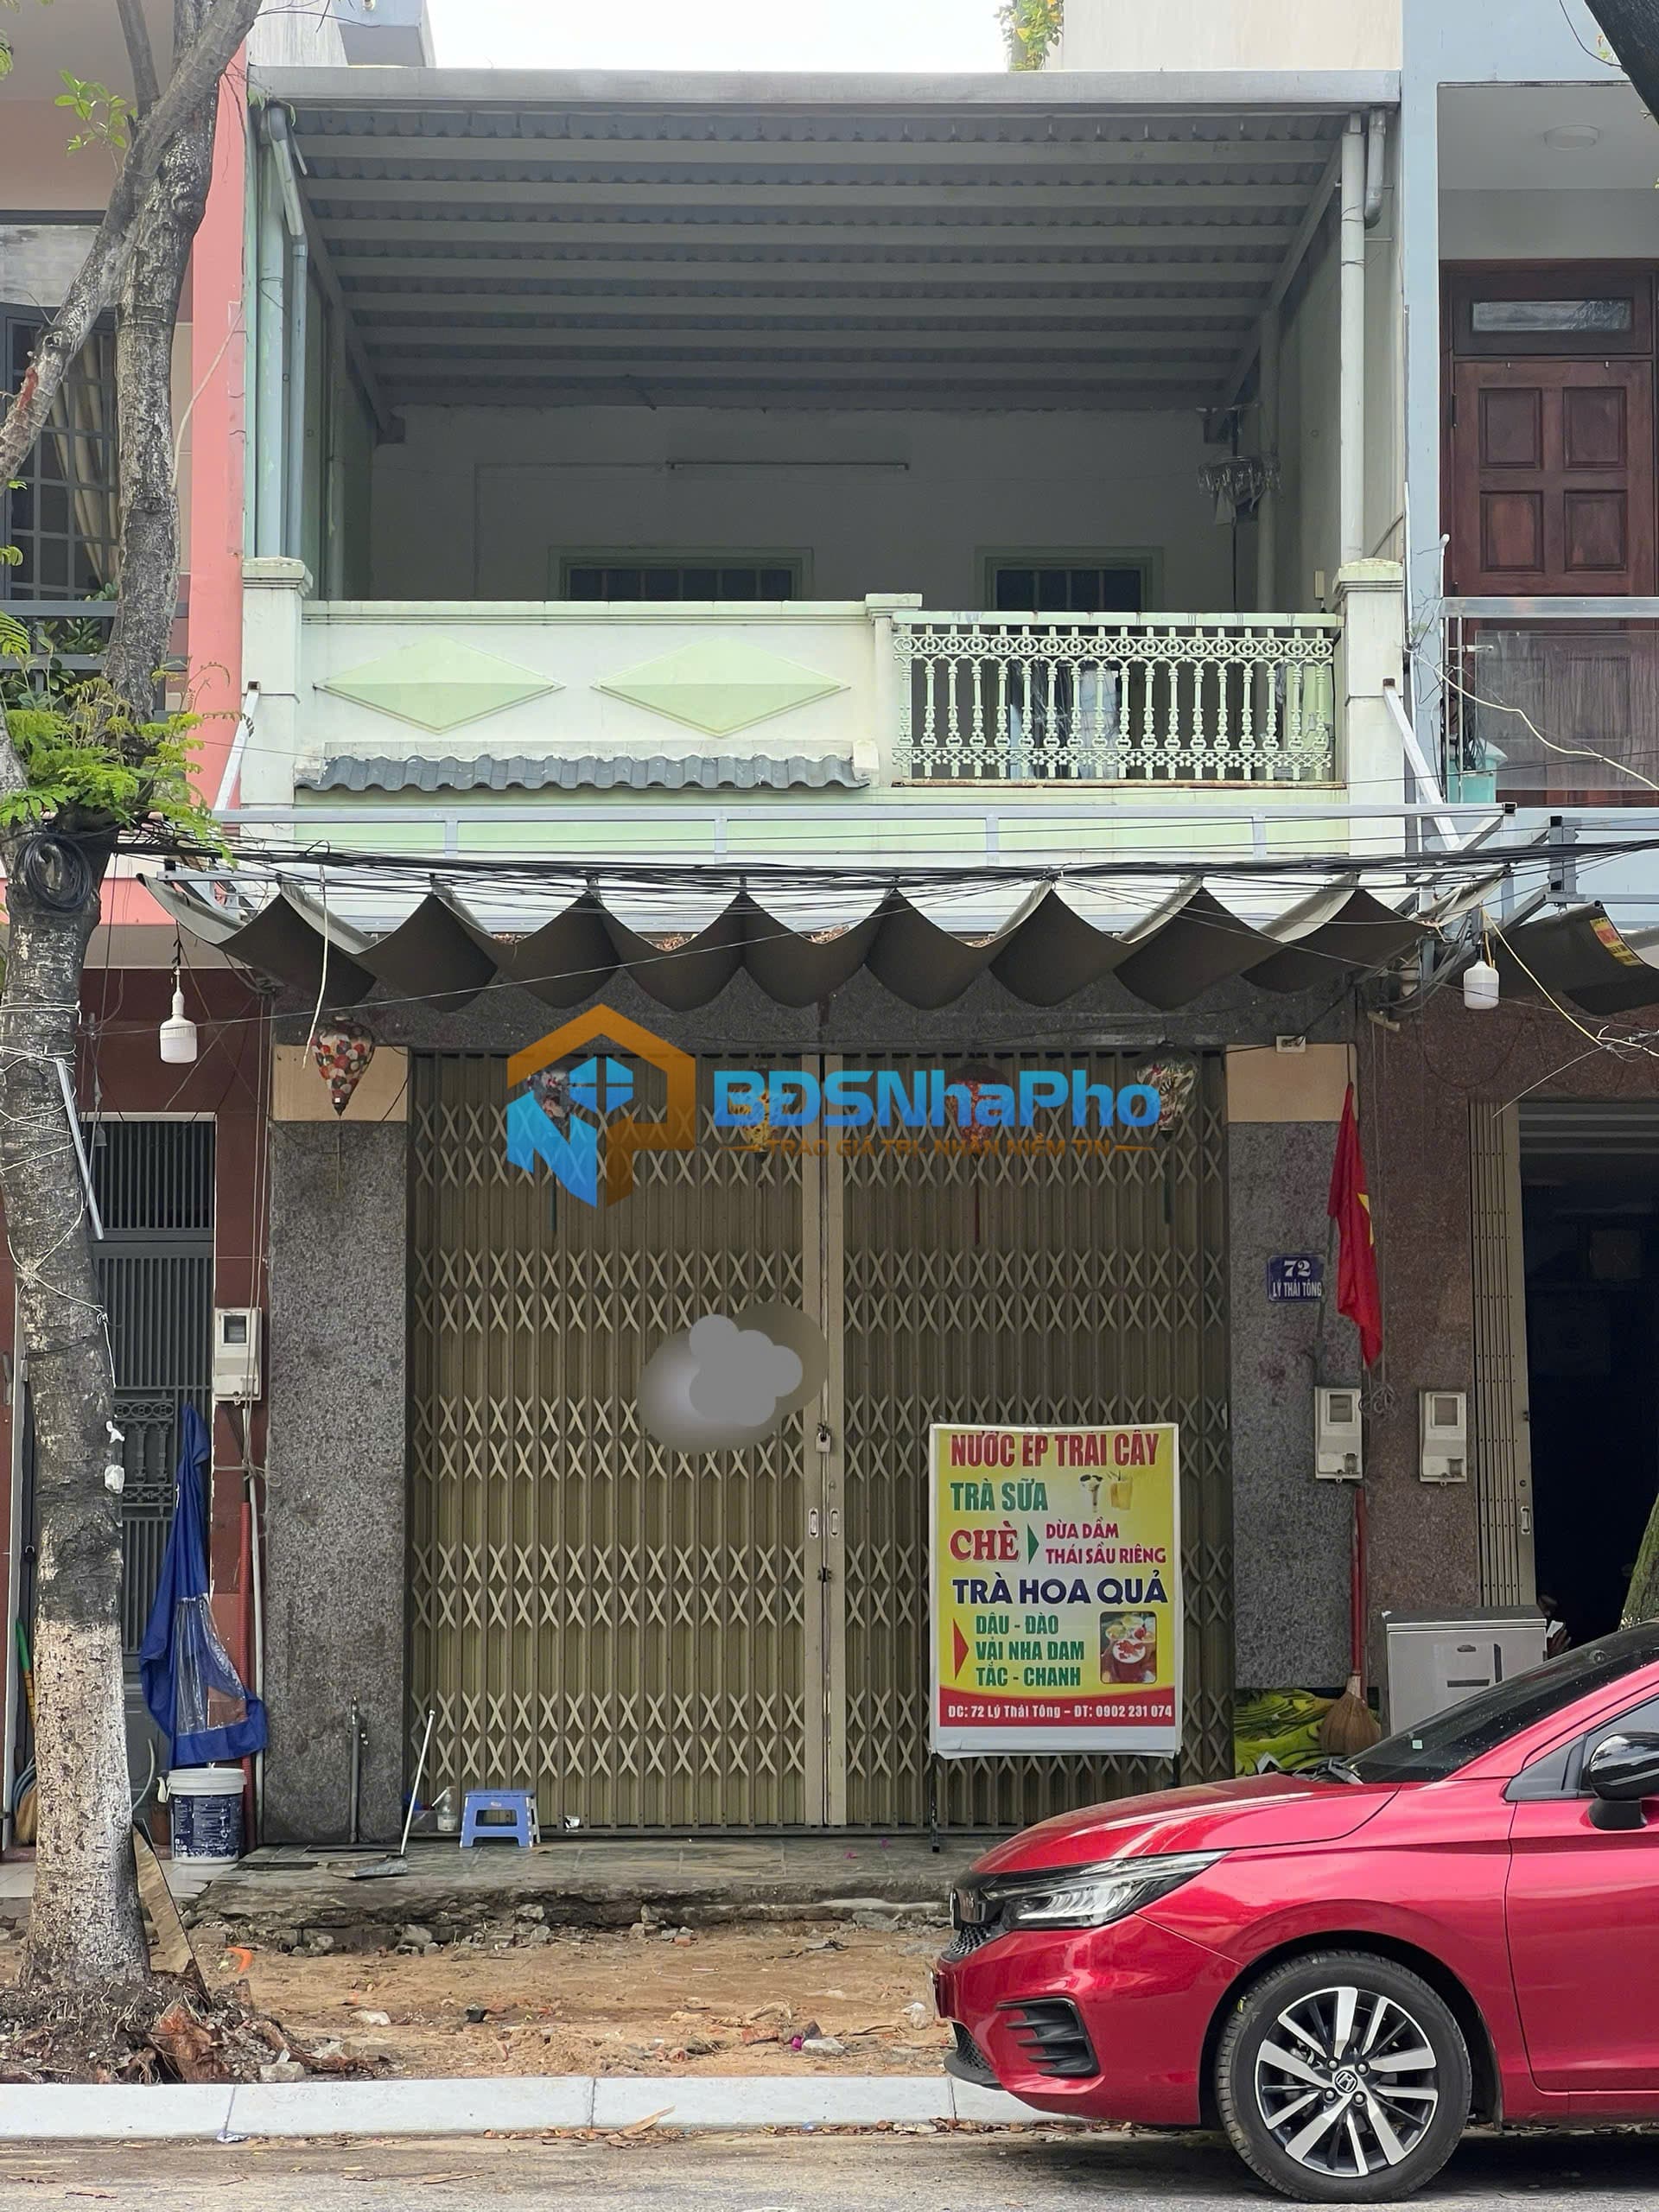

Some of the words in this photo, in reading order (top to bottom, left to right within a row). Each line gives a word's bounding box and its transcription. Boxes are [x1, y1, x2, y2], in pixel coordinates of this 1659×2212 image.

[1284, 1260, 1311, 1277] 72
[951, 1431, 1015, 1467] NƯỚC
[1115, 1429, 1160, 1466] CÂY
[950, 1478, 995, 1511] TRÀ
[1001, 1478, 1049, 1512] SỮA
[950, 1520, 1019, 1561] CHÈ
[1046, 1518, 1078, 1539] DỪA
[1046, 1543, 1082, 1564] THÁI
[1085, 1541, 1116, 1564] SẦU
[1119, 1543, 1166, 1564] RIÊNG
[952, 1571, 1014, 1605] TRÀ
[1019, 1578, 1091, 1605] HOA
[1096, 1569, 1168, 1605] QUẢ
[976, 1611, 1009, 1635] DÂU
[1025, 1611, 1058, 1635] ĐÀO
[1008, 1641, 1043, 1660] NHA
[976, 1661, 1008, 1687] TẮC
[1023, 1667, 1081, 1687] CHANH
[970, 1705, 985, 1718] 72
[987, 1704, 1001, 1719] Lý
[1003, 1704, 1029, 1718] Thái
[1096, 1705, 1126, 1718] 0902
[1128, 1705, 1148, 1718] 231
[1151, 1705, 1173, 1718] 074
